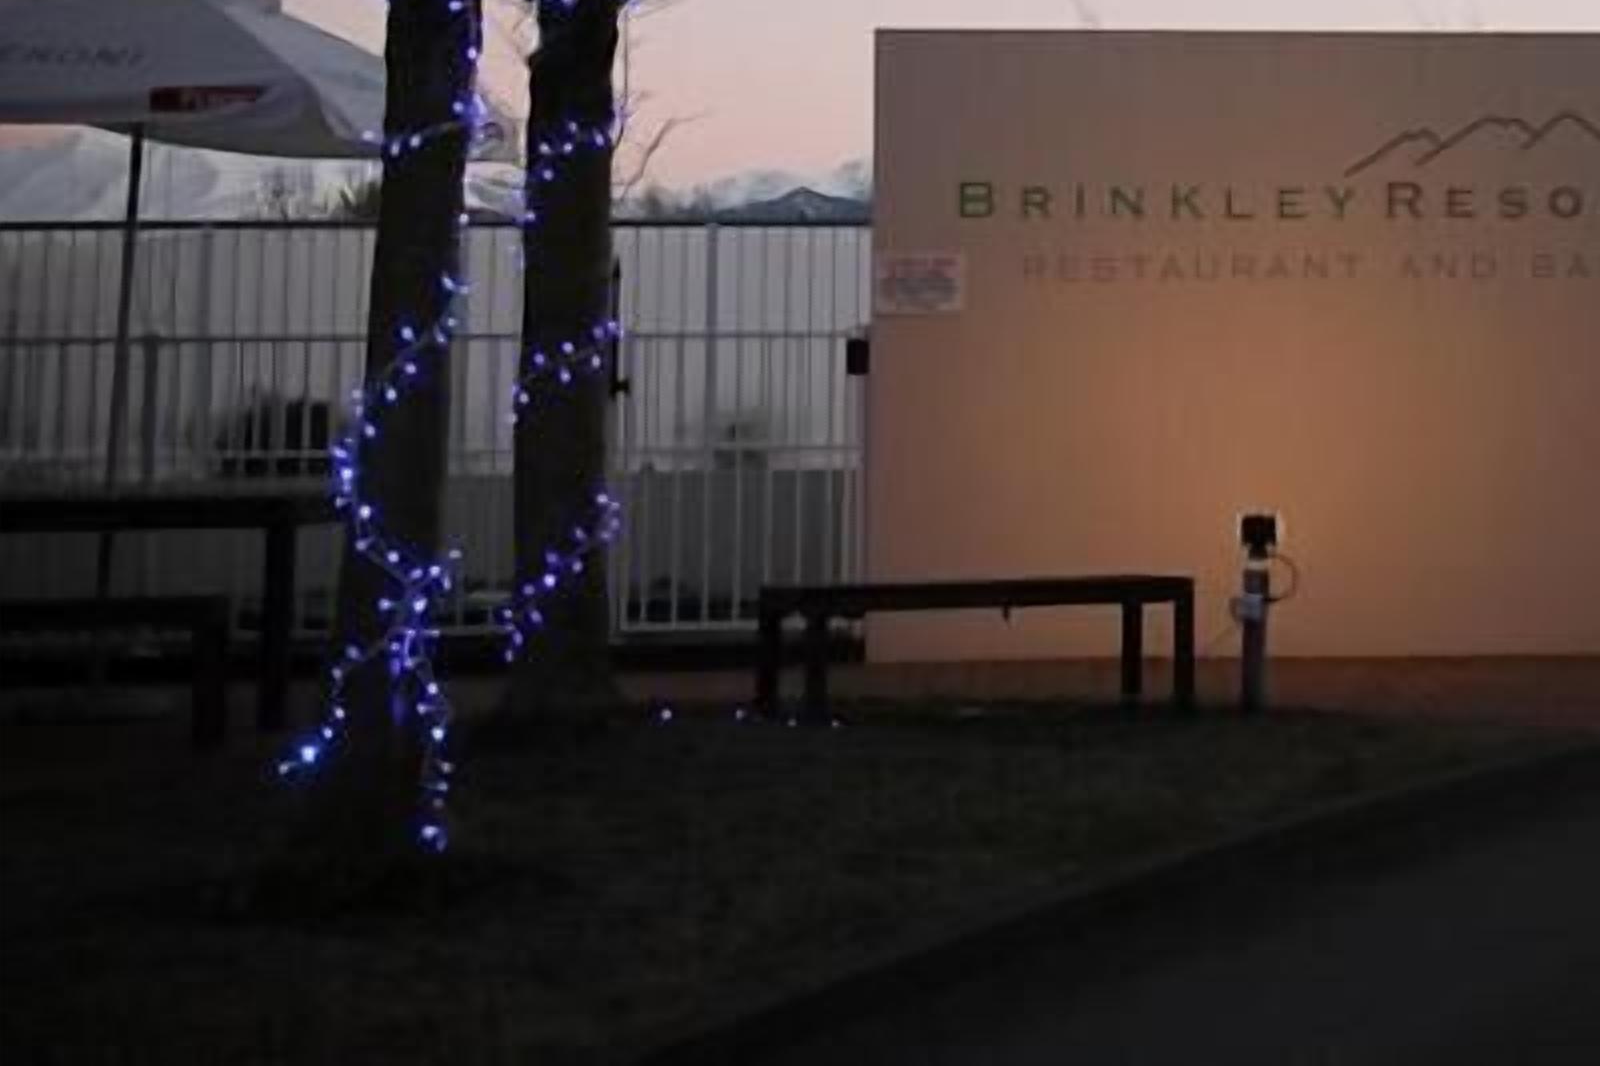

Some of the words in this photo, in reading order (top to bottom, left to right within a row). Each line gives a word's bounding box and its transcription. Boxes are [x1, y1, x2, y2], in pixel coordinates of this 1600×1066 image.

[959, 181, 1354, 220] BRINKLEY
[1023, 252, 1367, 280] RESTAURANT
[1402, 252, 1497, 280] AND
